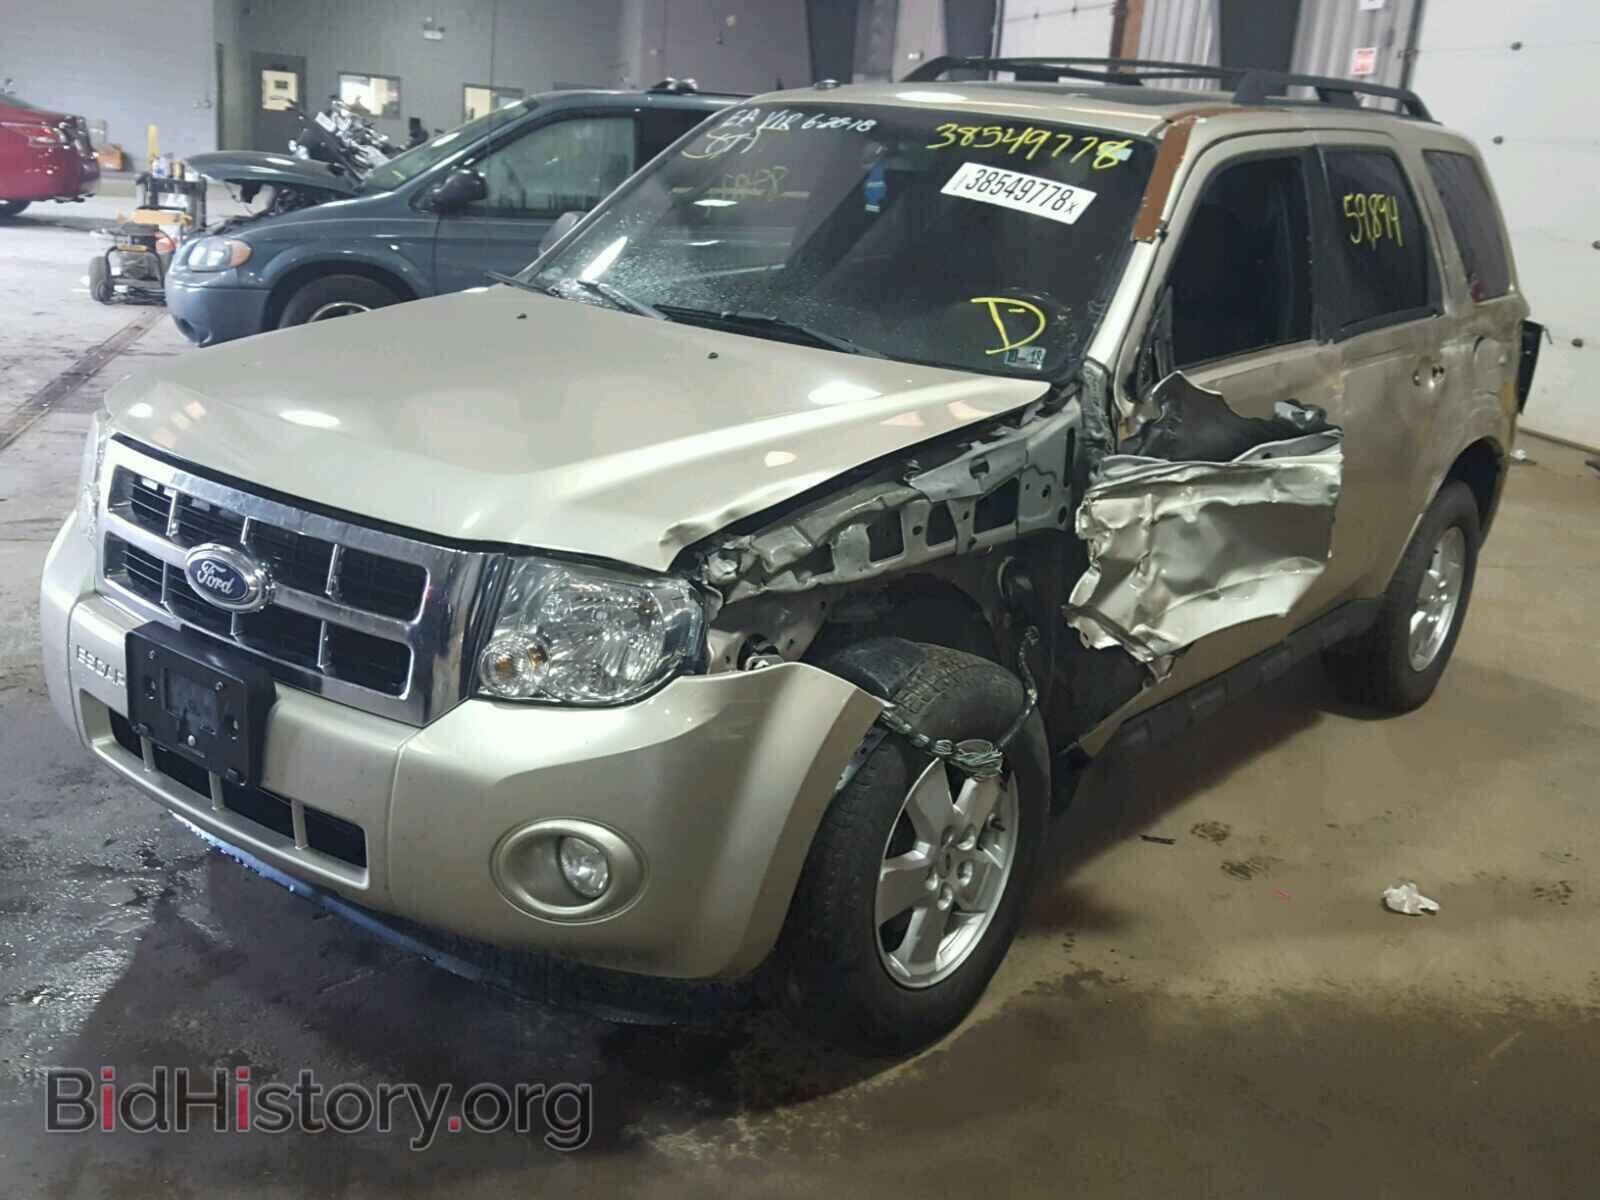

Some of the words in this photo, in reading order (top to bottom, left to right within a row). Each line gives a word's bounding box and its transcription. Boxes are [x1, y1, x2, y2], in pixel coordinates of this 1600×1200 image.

[925, 123, 1134, 170] 38549778
[965, 169, 1074, 212] 38549778
[970, 296, 1046, 355] D
[196, 560, 235, 595] Ford
